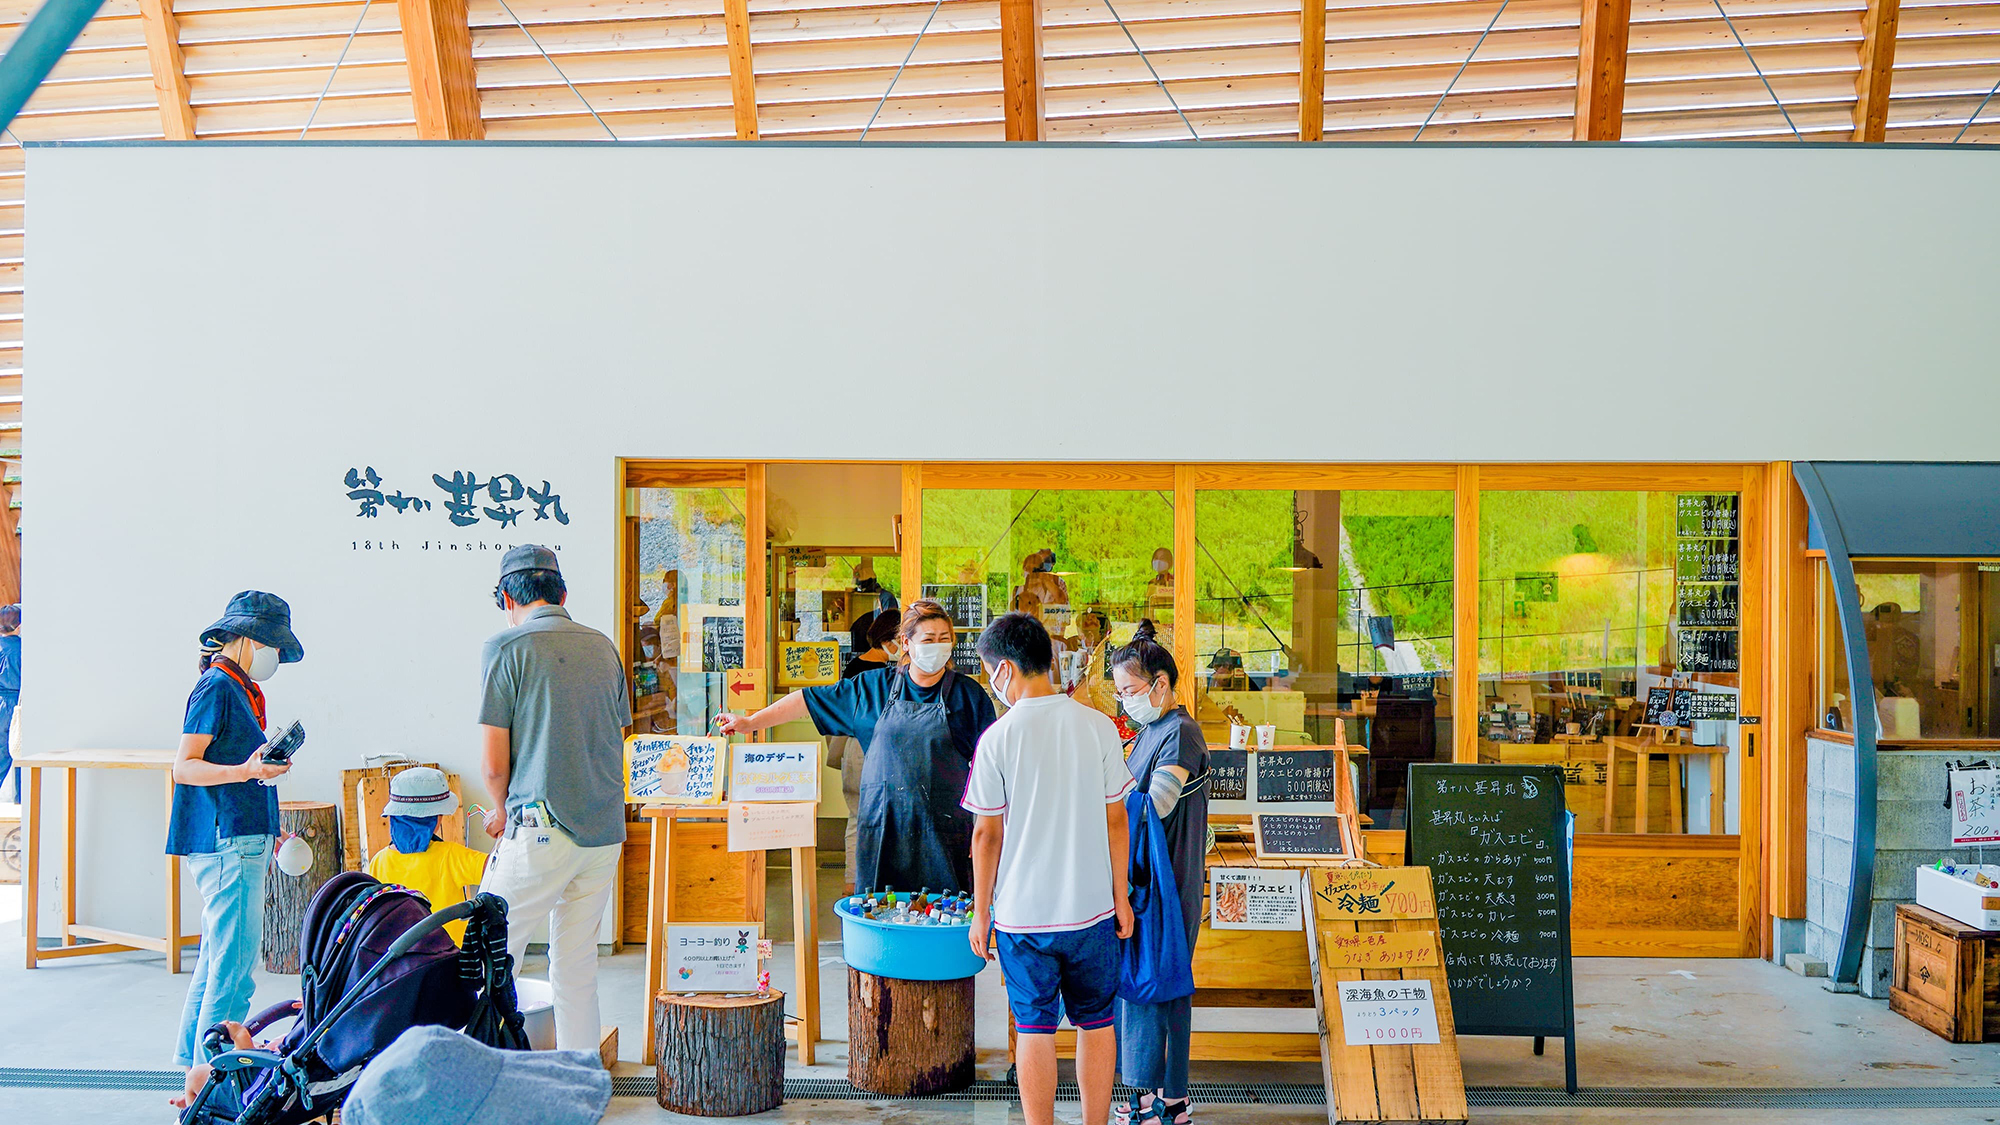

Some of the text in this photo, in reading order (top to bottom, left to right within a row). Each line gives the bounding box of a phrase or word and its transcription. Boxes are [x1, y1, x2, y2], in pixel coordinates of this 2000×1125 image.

[352, 541, 400, 551] 18th
[1679, 600, 1737, 608] ガスエビカレー
[1679, 652, 1709, 666] 冷麺
[735, 671, 753, 679] 入口
[745, 753, 804, 763] 海のデザート
[1259, 756, 1294, 767] 甚昇丸の
[1210, 767, 1245, 777] の唐揚げ
[1259, 767, 1332, 778] ガスエビの唐揚げ
[1287, 781, 1332, 792] 500円(税込)
[1436, 779, 1516, 796] 第十八甚昇丸
[1969, 777, 1988, 818] お茶
[1429, 809, 1504, 826] 甚昇丸といえば
[1961, 825, 1990, 837] 200
[1535, 874, 1555, 884] 400円
[1248, 884, 1293, 894] ガスエビ！
[1337, 891, 1432, 914] 冷麺 700円
[1438, 889, 1556, 906] ガスエビの天巻き 300円
[1438, 906, 1557, 923] ガスエビのカレー 500円
[1439, 926, 1557, 944] ガスエビの冷麺 700円
[680, 937, 731, 946] ヨーヨー釣り
[1334, 934, 1387, 949] 愛知県一色産
[1445, 951, 1558, 975] 店内にて販売しております
[1448, 973, 1532, 991] いかがでしょうか？
[1346, 988, 1426, 1000] 深海魚の干物
[1365, 1027, 1423, 1039] 1000円
